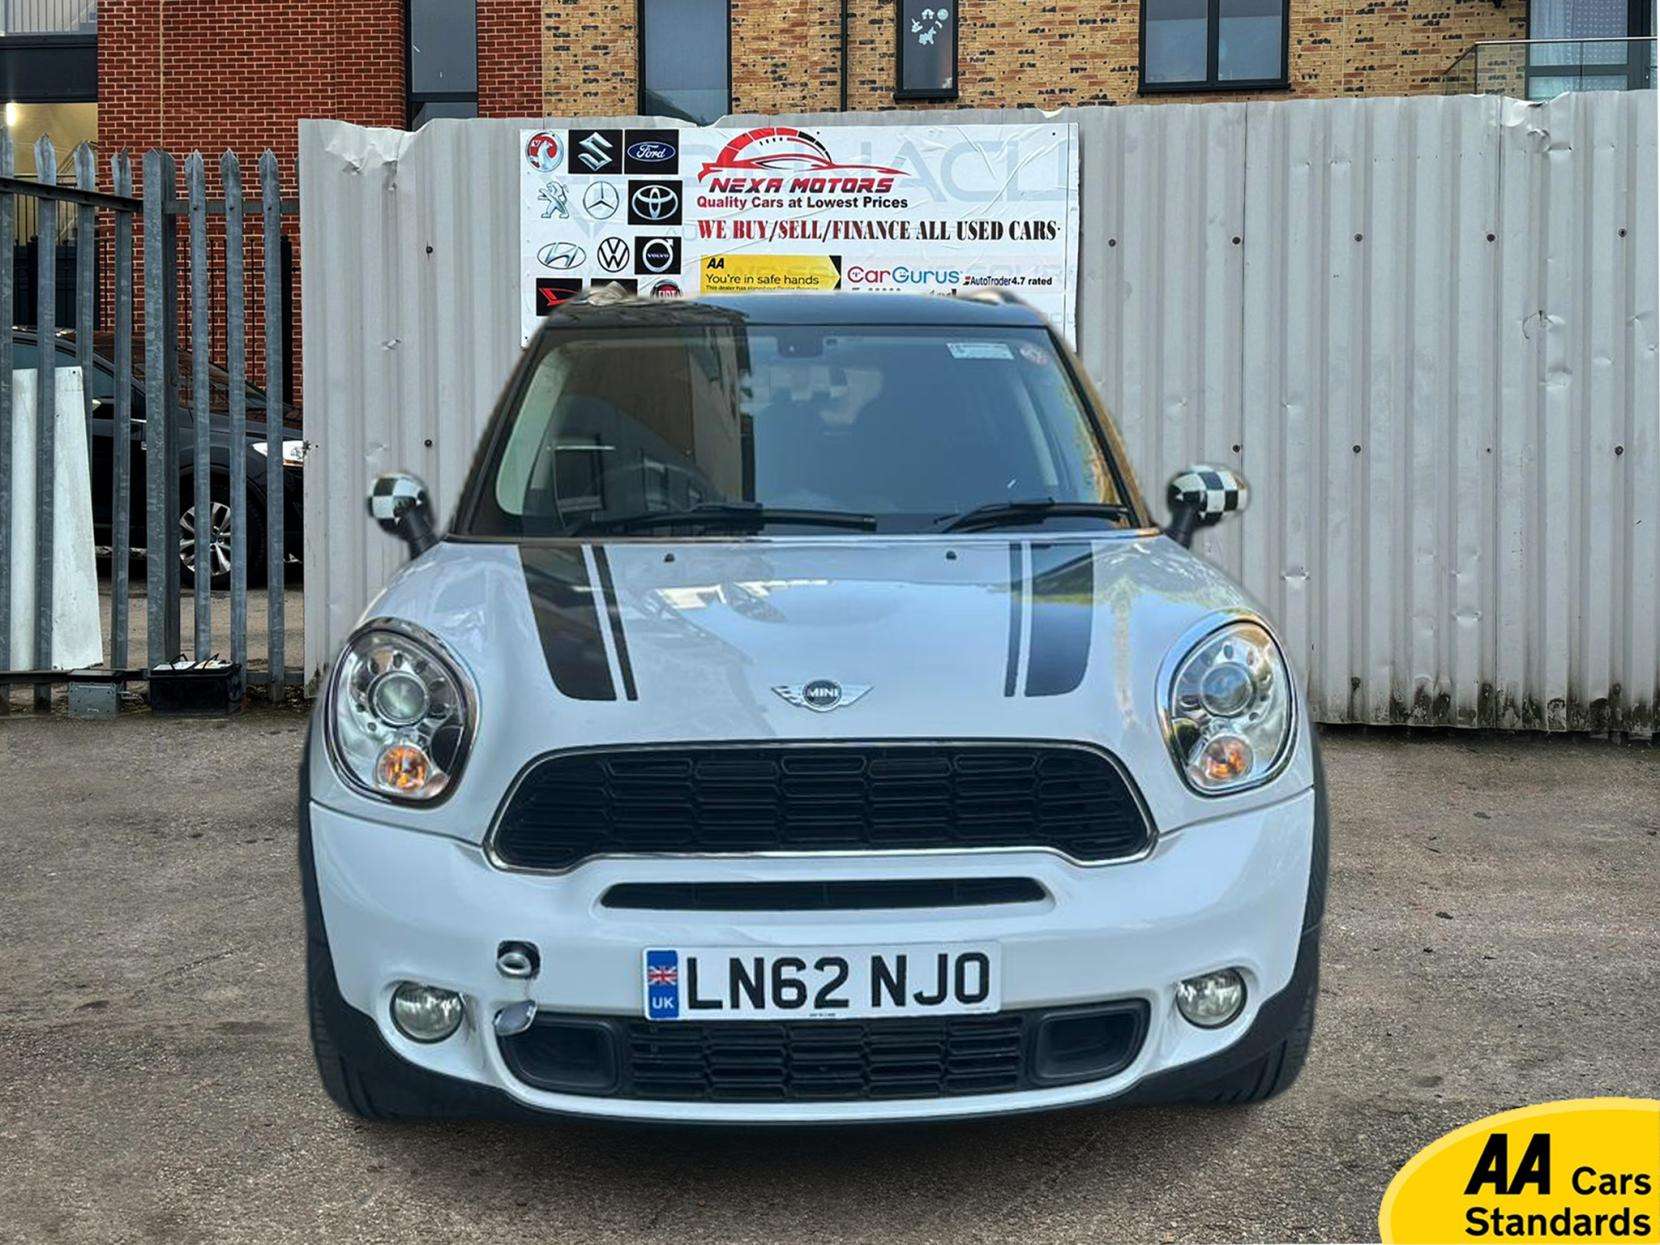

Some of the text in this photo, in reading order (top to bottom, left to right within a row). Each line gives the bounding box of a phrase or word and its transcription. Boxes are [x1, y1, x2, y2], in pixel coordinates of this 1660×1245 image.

[635, 144, 667, 159] Ford
[709, 177, 894, 194] NEXA MOTORS
[697, 196, 908, 210] Quality Cars at Lowest Prices
[697, 220, 727, 240] WE
[916, 220, 951, 241] ALL
[956, 220, 1004, 241] USED
[706, 257, 725, 270] AA
[706, 274, 819, 285] You're in safe hands
[847, 266, 960, 284] CarGurus
[1028, 276, 1053, 285] rated
[807, 687, 838, 697] MINI
[687, 952, 990, 1010] LN62 NJO
[652, 996, 675, 1010] UK
